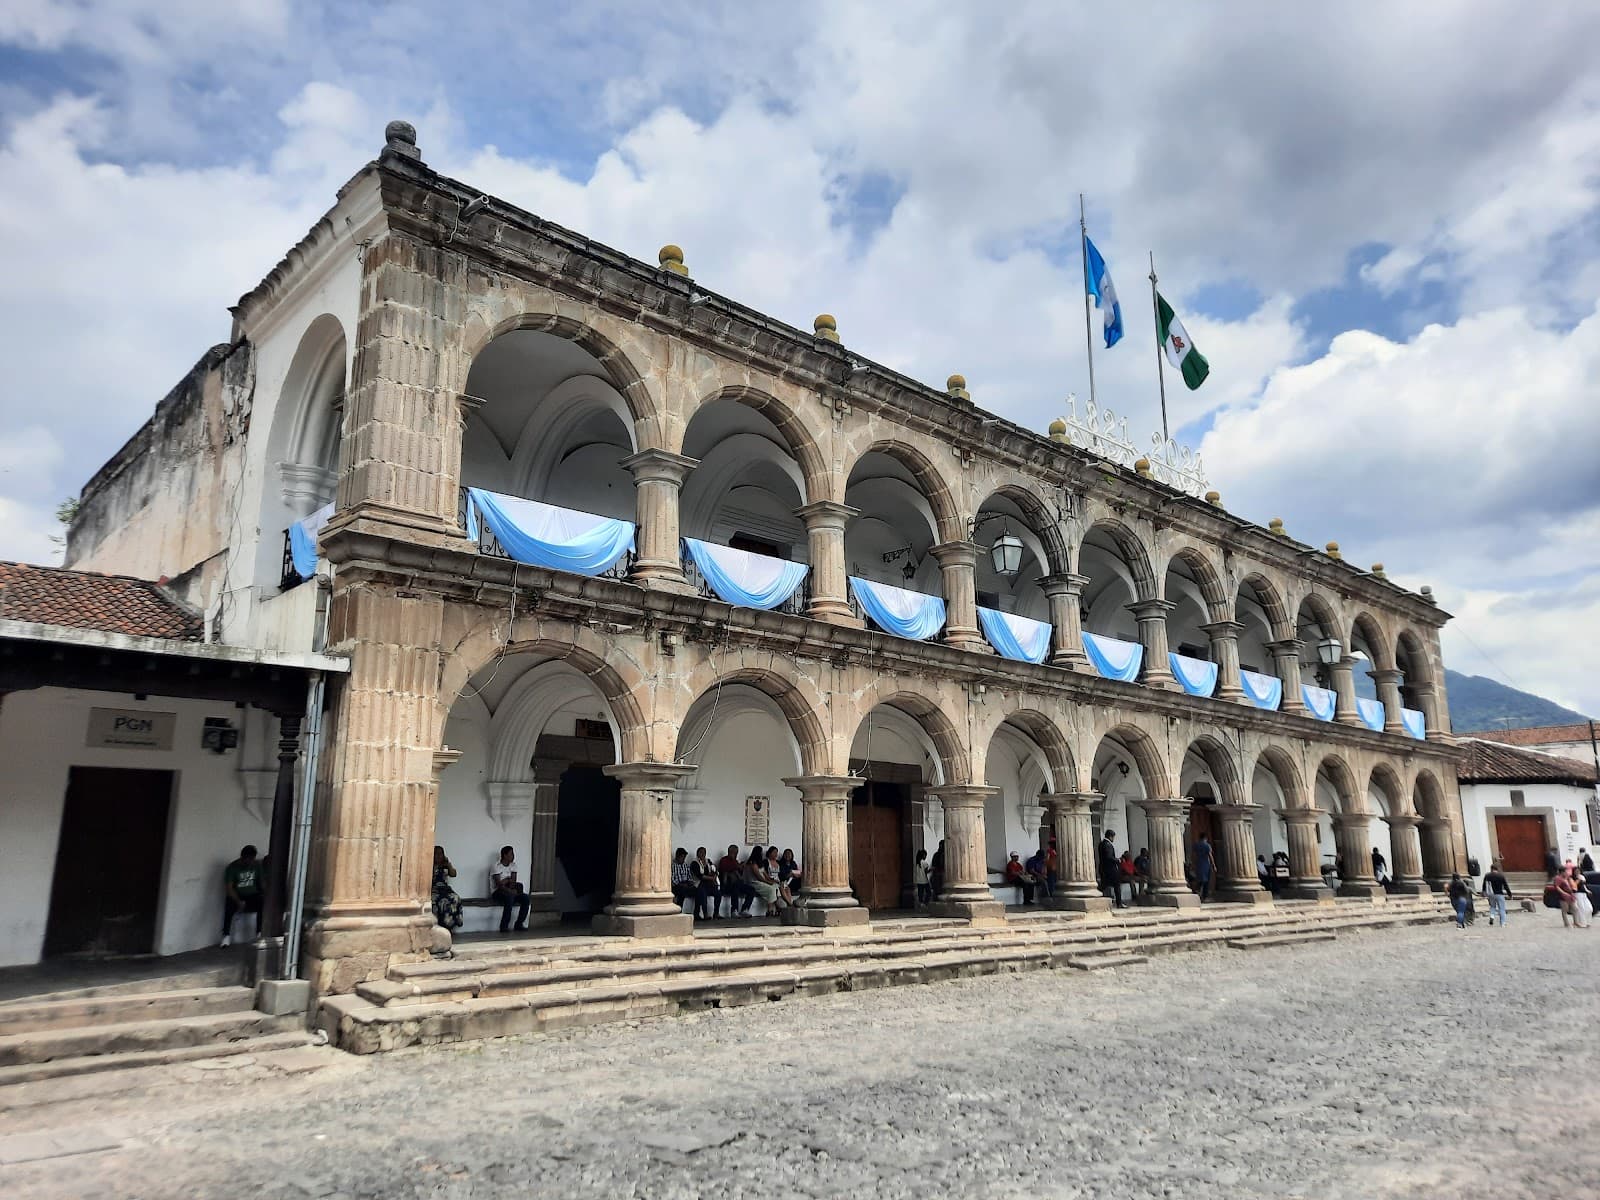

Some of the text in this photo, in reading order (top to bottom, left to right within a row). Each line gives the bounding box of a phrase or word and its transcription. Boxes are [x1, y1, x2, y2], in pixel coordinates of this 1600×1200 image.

[1065, 392, 1131, 445] 1821
[1151, 431, 1205, 481] 2024
[113, 716, 153, 731] PGN
